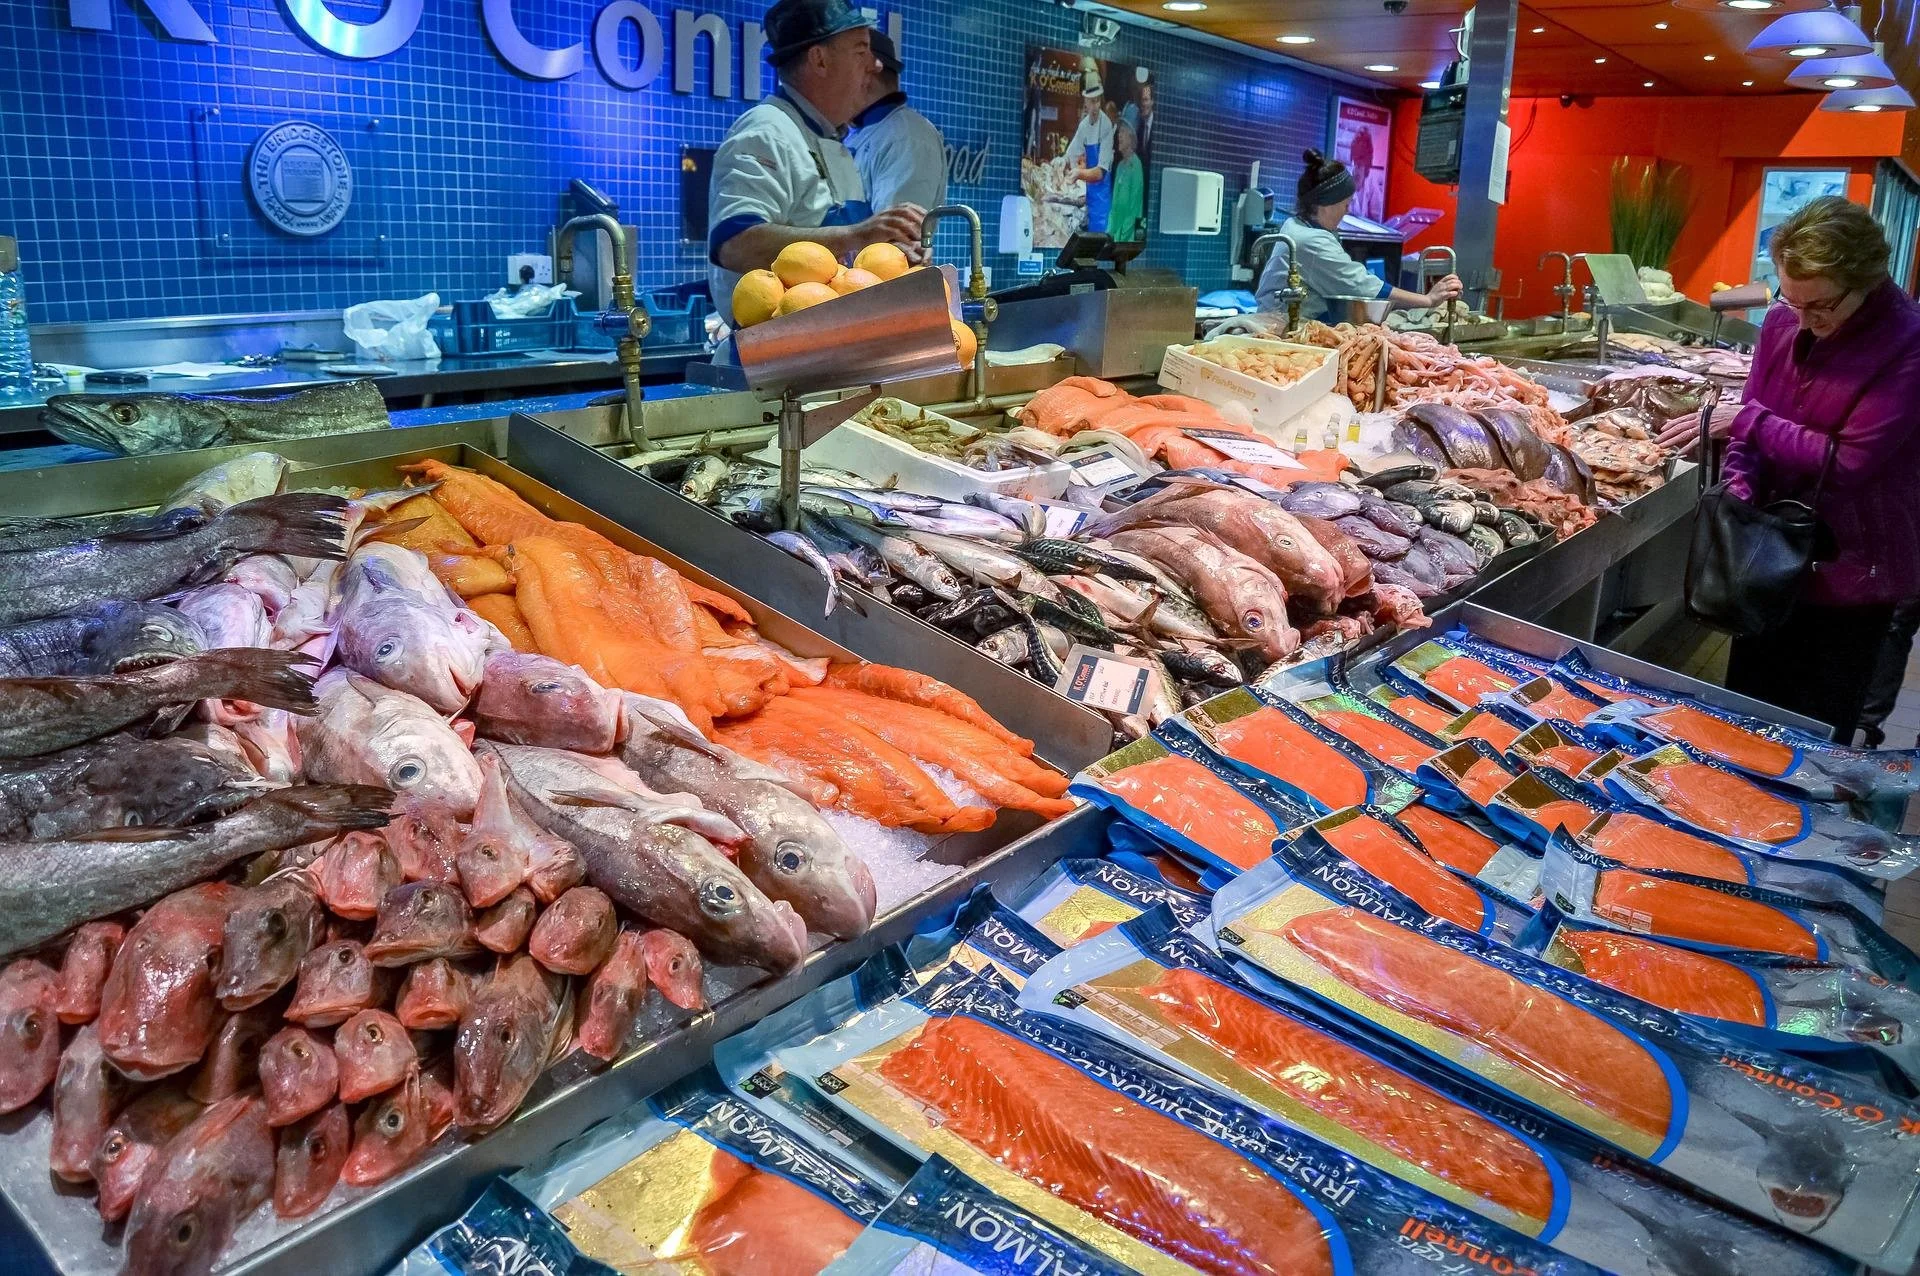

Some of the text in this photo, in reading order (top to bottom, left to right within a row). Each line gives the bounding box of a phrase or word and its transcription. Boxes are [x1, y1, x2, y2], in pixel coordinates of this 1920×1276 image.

[256, 152, 271, 189] THE
[265, 128, 348, 190] BRIDGESTONE
[1568, 658, 1613, 687] SALMON
[1548, 718, 1585, 742] SALM
[1015, 1018, 1042, 1039] OAK
[1051, 1037, 1088, 1058] OVER
[1098, 1059, 1165, 1095] IRELAND
[1177, 1096, 1193, 1108] IN
[1275, 1150, 1356, 1207] IRISH
[943, 1201, 1083, 1276] ALMON
